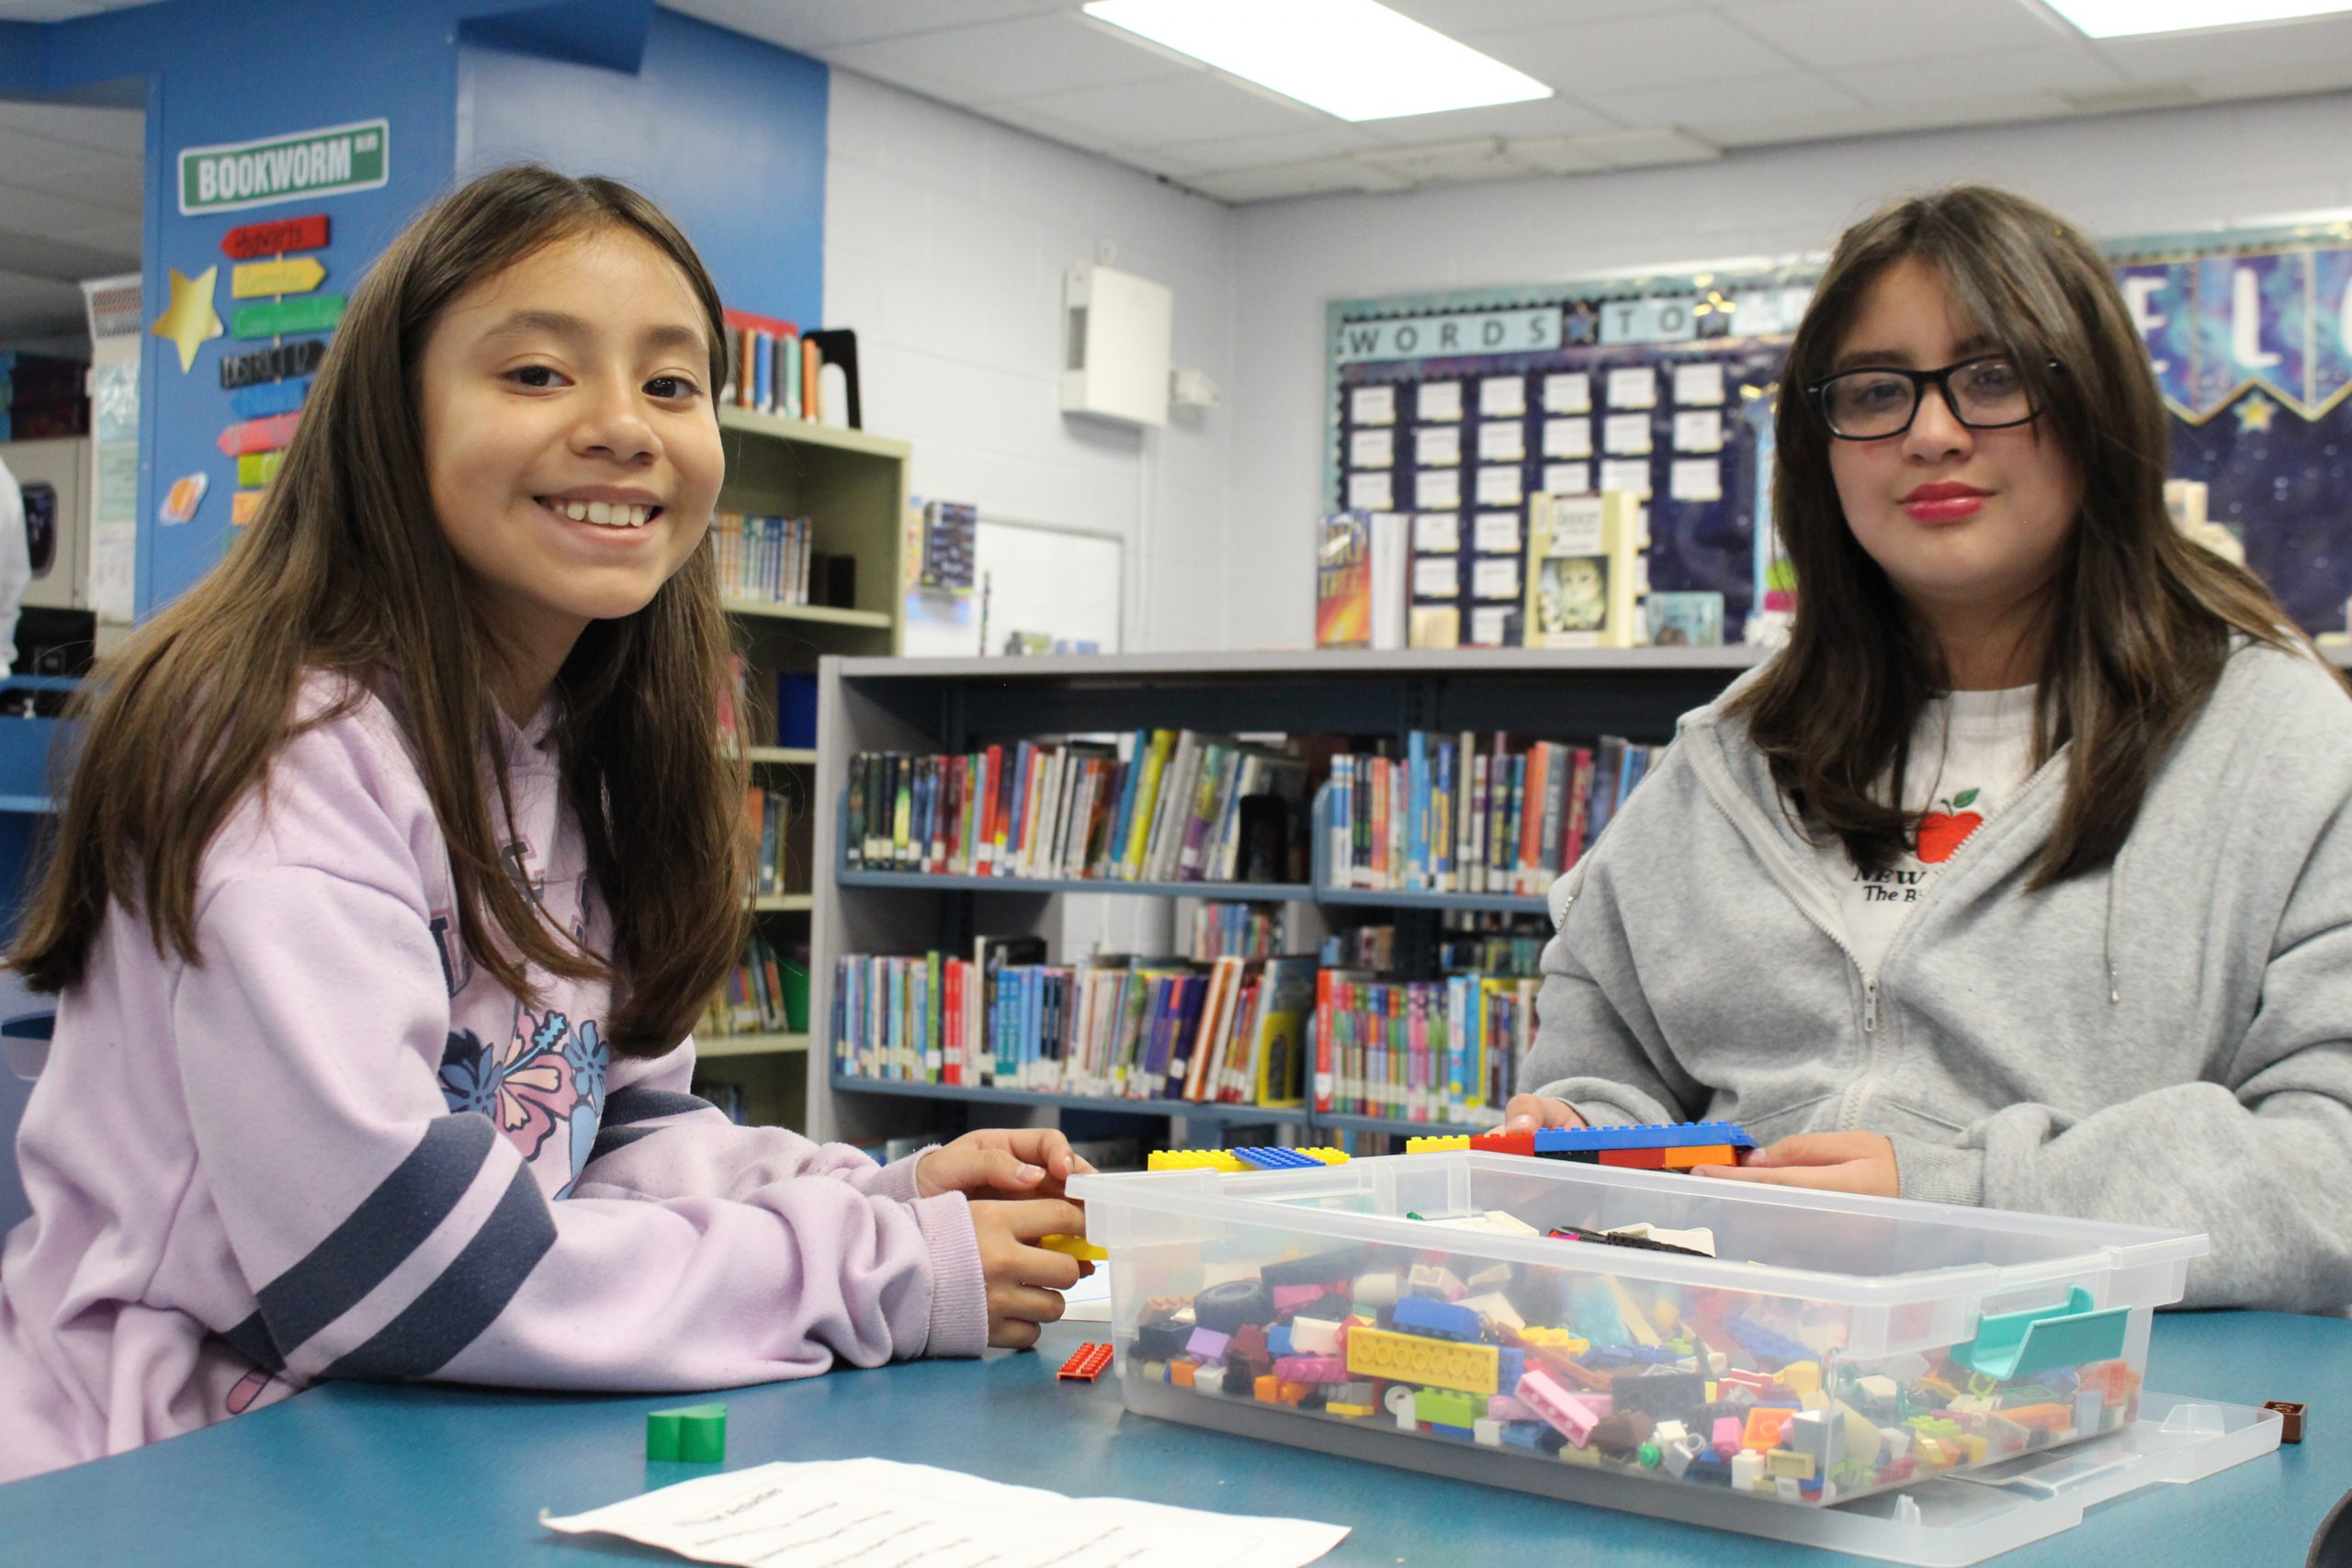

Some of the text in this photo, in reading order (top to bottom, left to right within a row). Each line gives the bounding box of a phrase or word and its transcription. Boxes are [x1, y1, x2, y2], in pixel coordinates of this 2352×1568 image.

[198, 138, 351, 202] BOOKWORM
[1349, 305, 1546, 355] WORDS
[1616, 305, 1686, 336] TO
[1851, 867, 1927, 886] NEW
[1863, 886, 1898, 902] The
